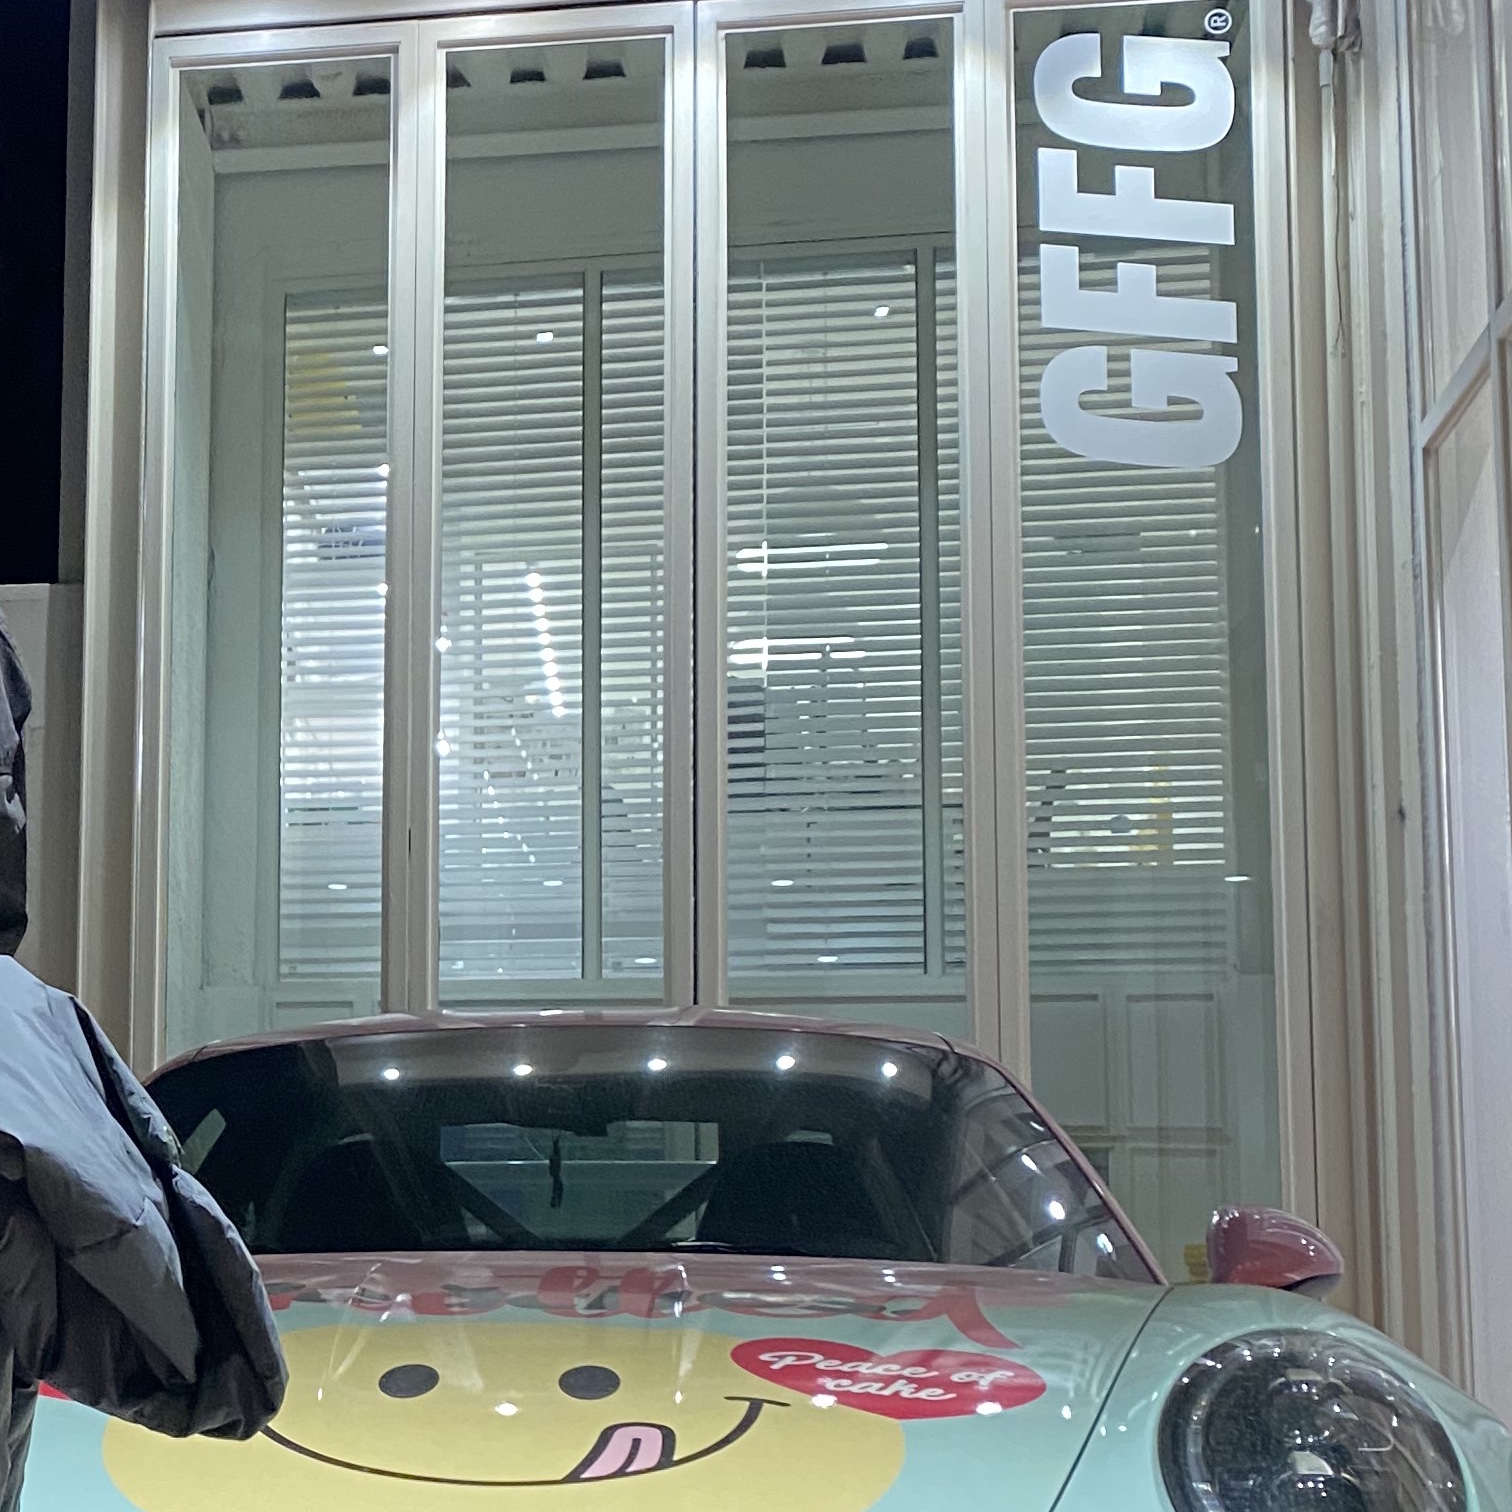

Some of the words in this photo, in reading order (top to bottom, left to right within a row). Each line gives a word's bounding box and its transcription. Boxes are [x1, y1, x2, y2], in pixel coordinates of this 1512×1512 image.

[758, 1351, 940, 1378] Peace
[950, 1370, 1015, 1390] of
[818, 1377, 958, 1401] cake
